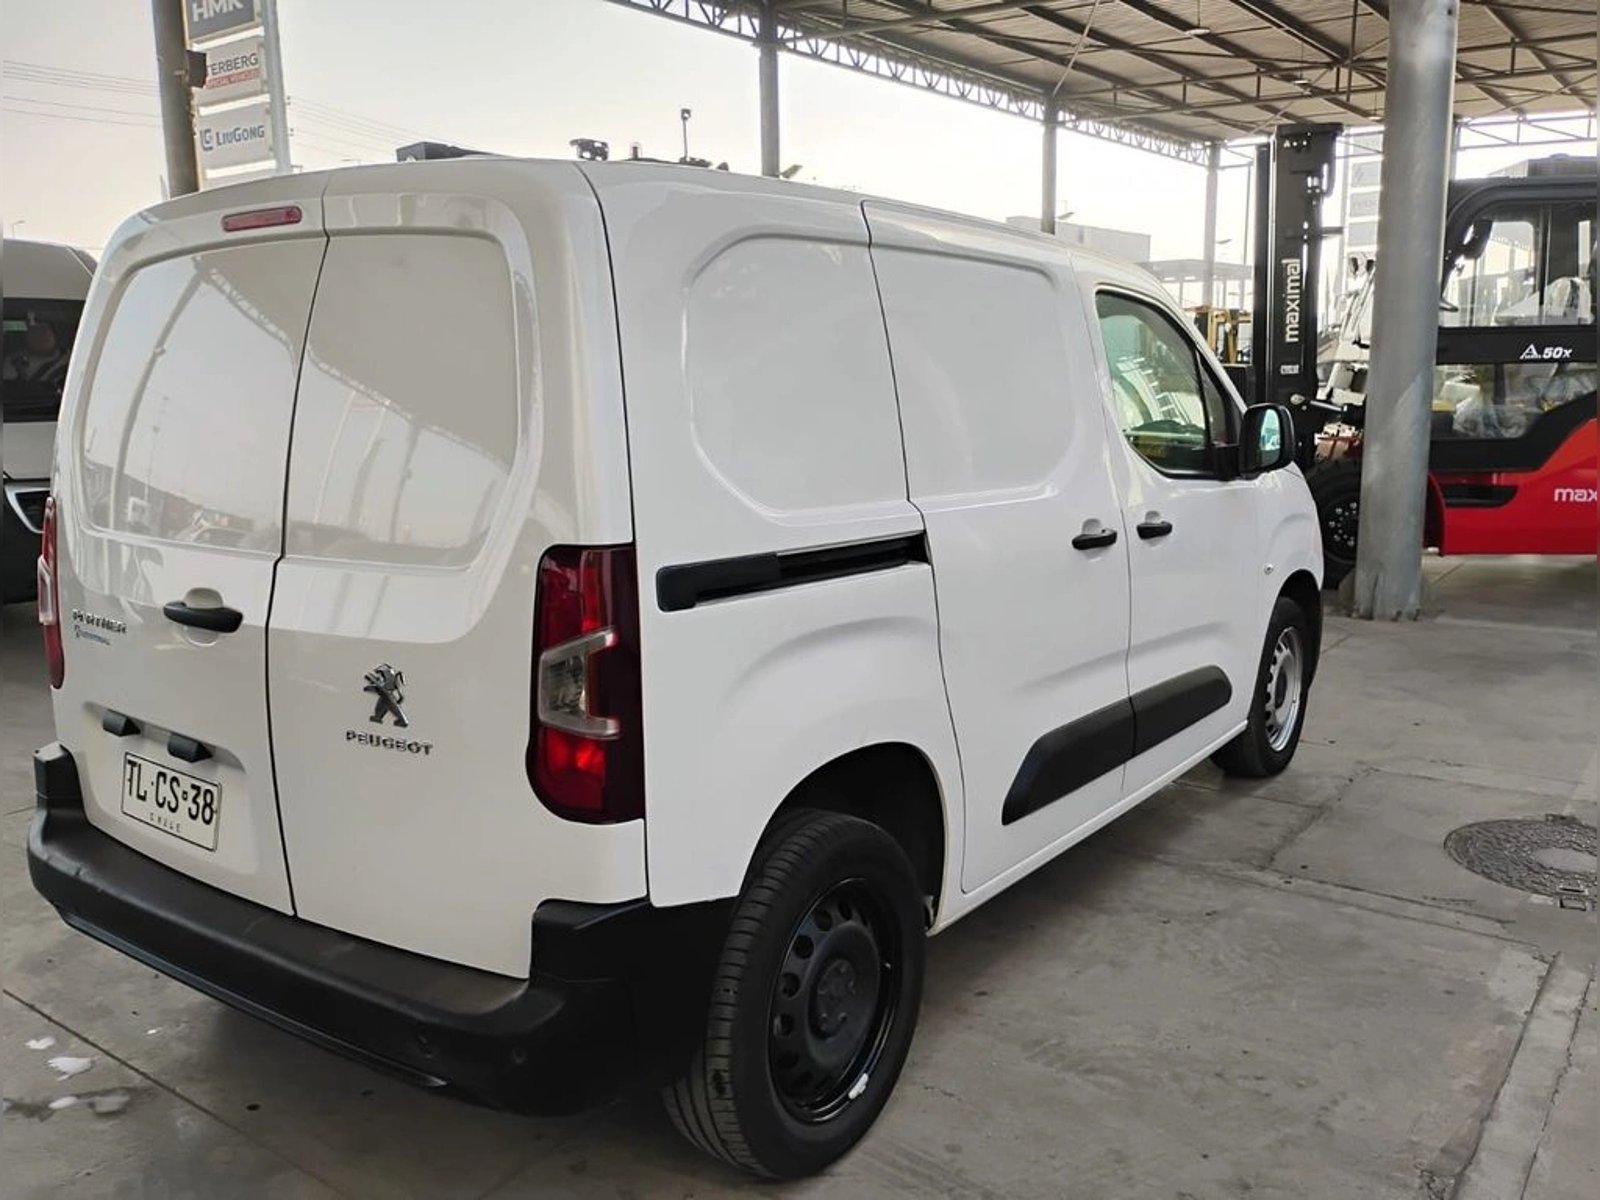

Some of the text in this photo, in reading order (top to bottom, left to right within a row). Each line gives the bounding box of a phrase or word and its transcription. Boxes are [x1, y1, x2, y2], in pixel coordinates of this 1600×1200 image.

[1281, 259, 1300, 342] maximal
[1554, 488, 1597, 502] max
[346, 730, 433, 755] PEUGEOT
